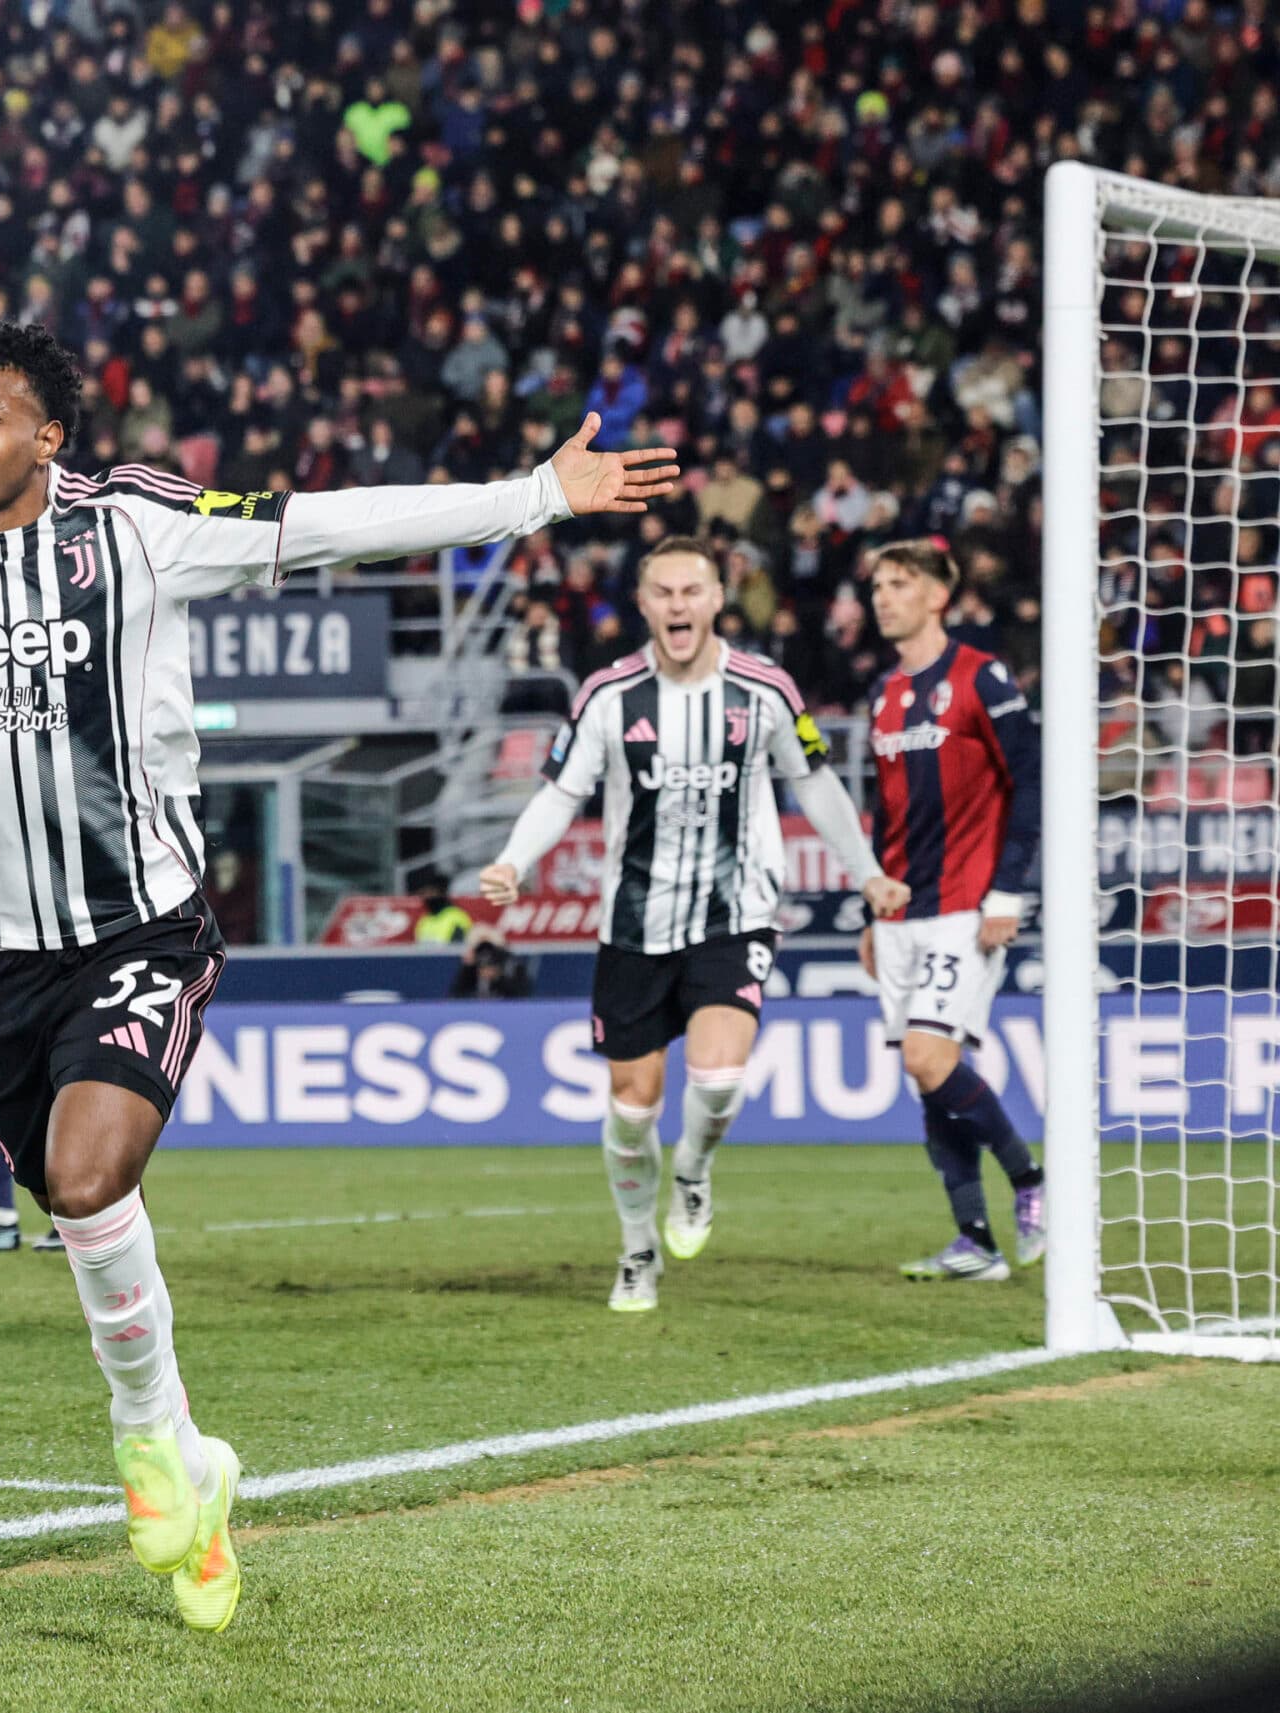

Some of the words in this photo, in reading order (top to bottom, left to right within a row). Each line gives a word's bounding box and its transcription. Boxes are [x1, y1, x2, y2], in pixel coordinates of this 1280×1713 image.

[189, 612, 352, 677] AENZA
[637, 754, 739, 797] Jeep
[747, 940, 773, 981] 8
[919, 952, 960, 991] 33
